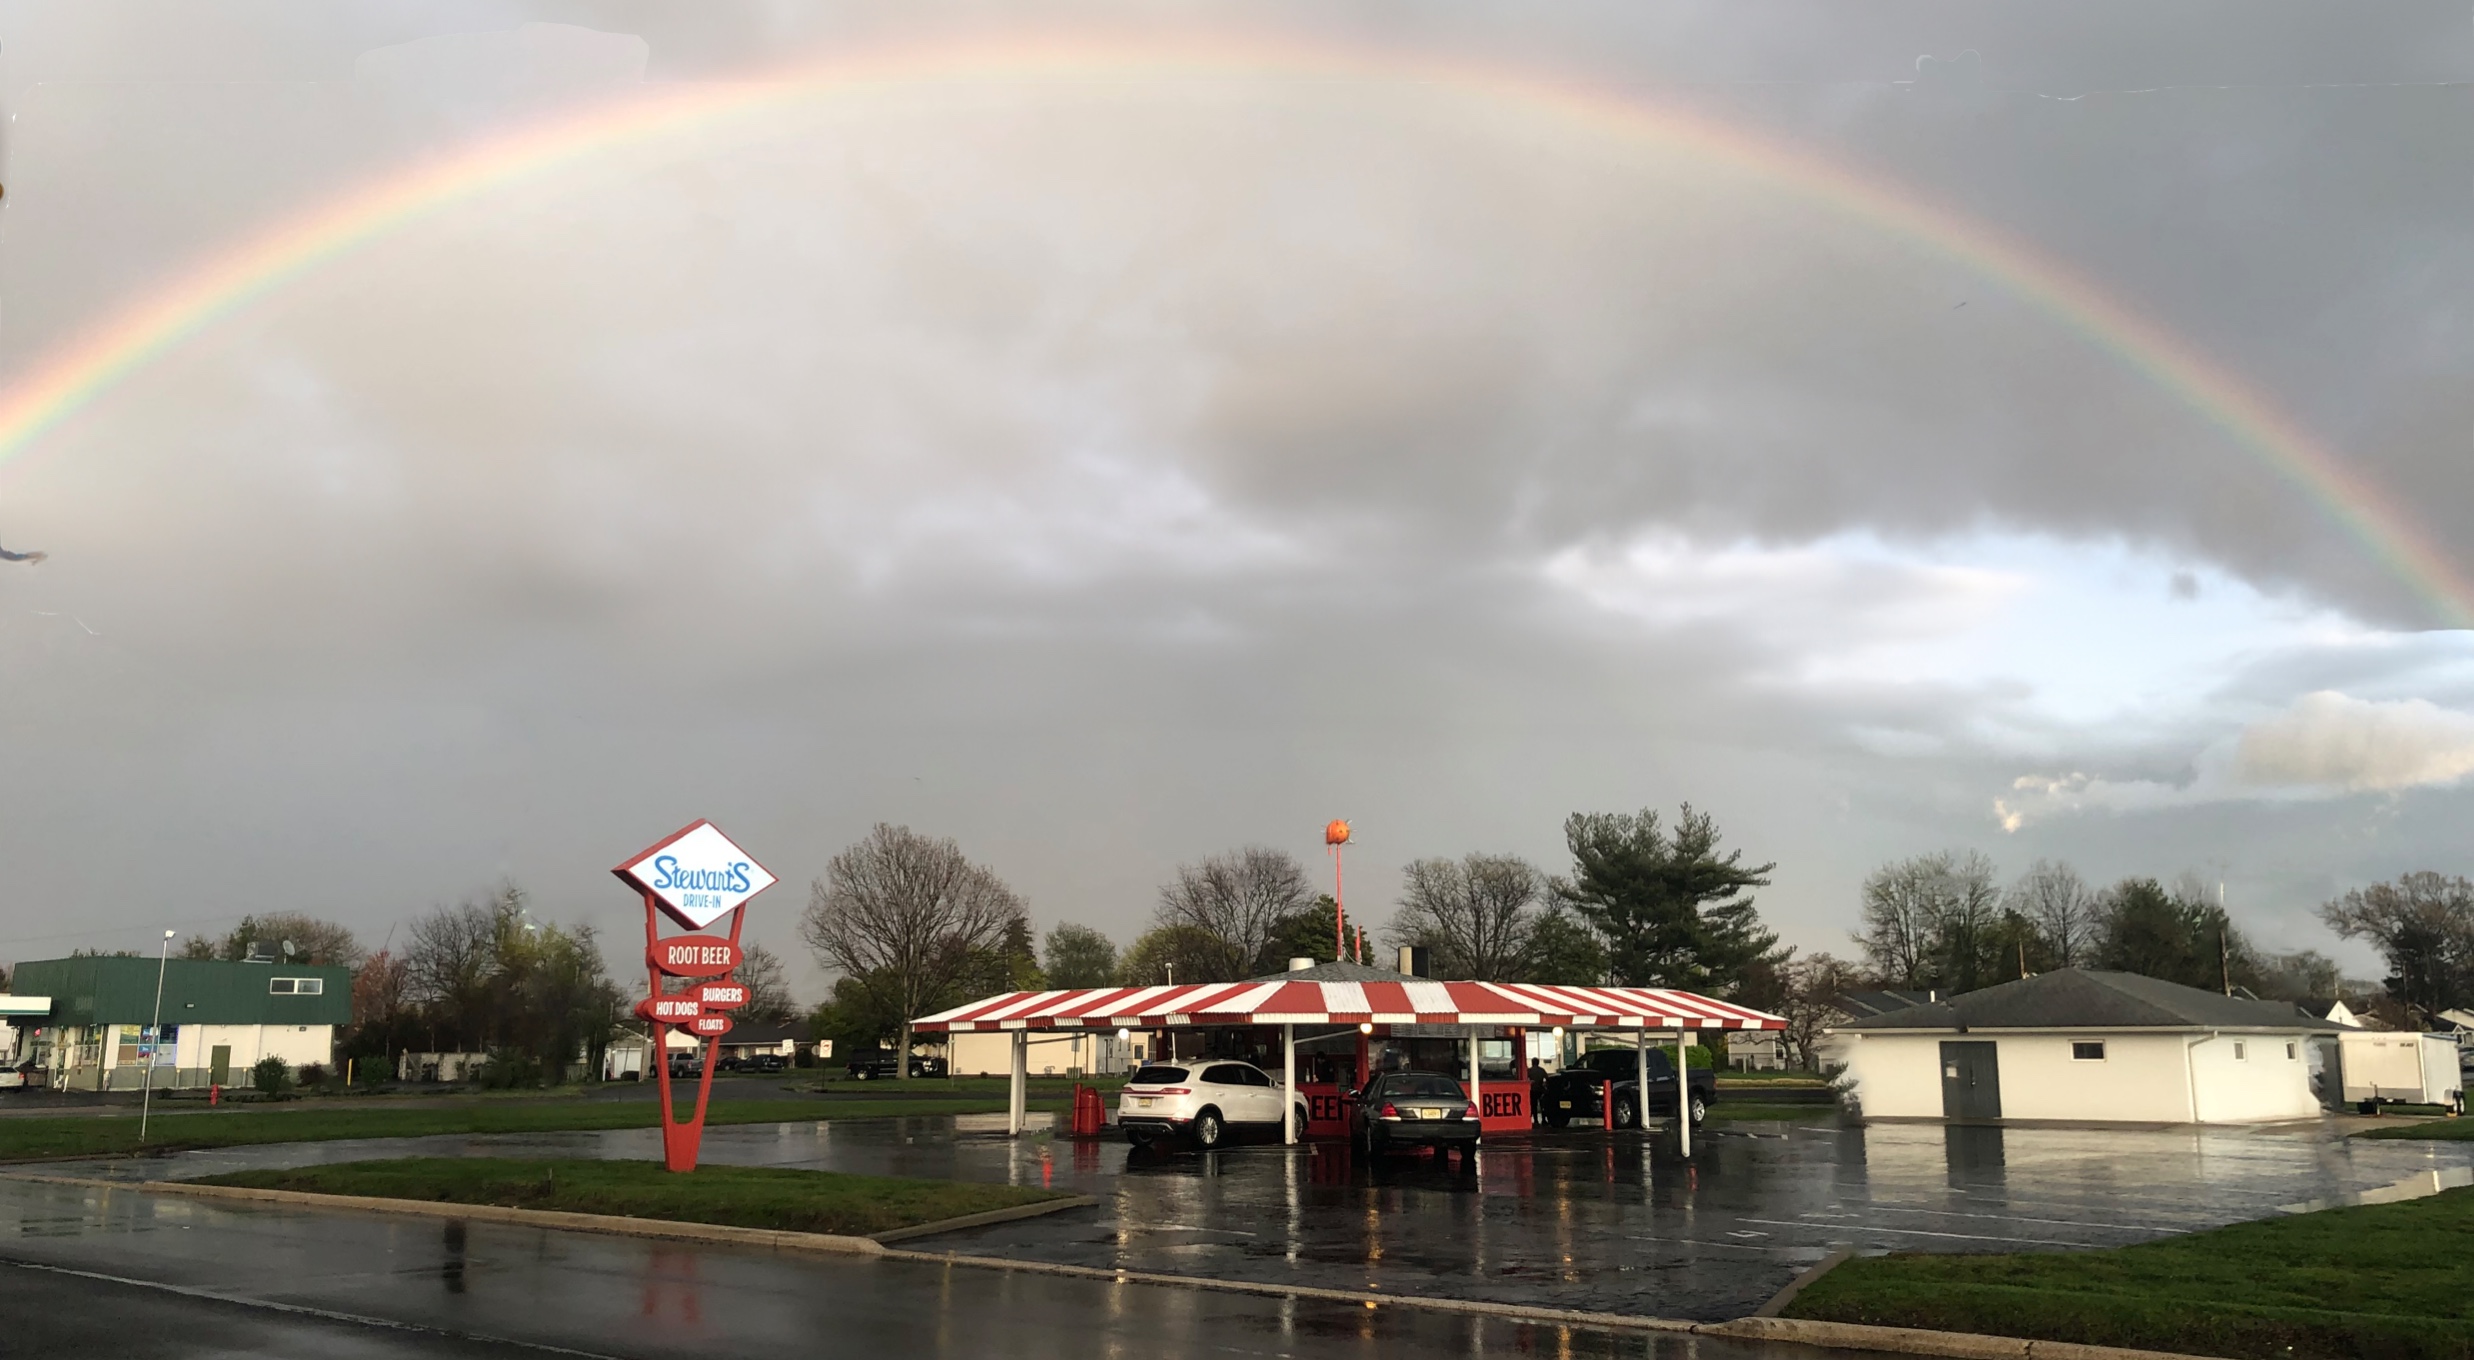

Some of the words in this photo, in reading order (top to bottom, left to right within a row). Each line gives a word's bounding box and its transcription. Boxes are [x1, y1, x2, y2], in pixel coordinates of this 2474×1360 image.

[683, 893, 721, 908] DRIVE-IN
[668, 946, 699, 965] ROOT
[701, 946, 731, 965] BEER
[702, 987, 743, 1002] BURGERS
[656, 1002, 674, 1016] HOT
[675, 1001, 698, 1016] DOGS
[698, 1018, 724, 1031] FLOATS
[1482, 1093, 1522, 1117] BEER
